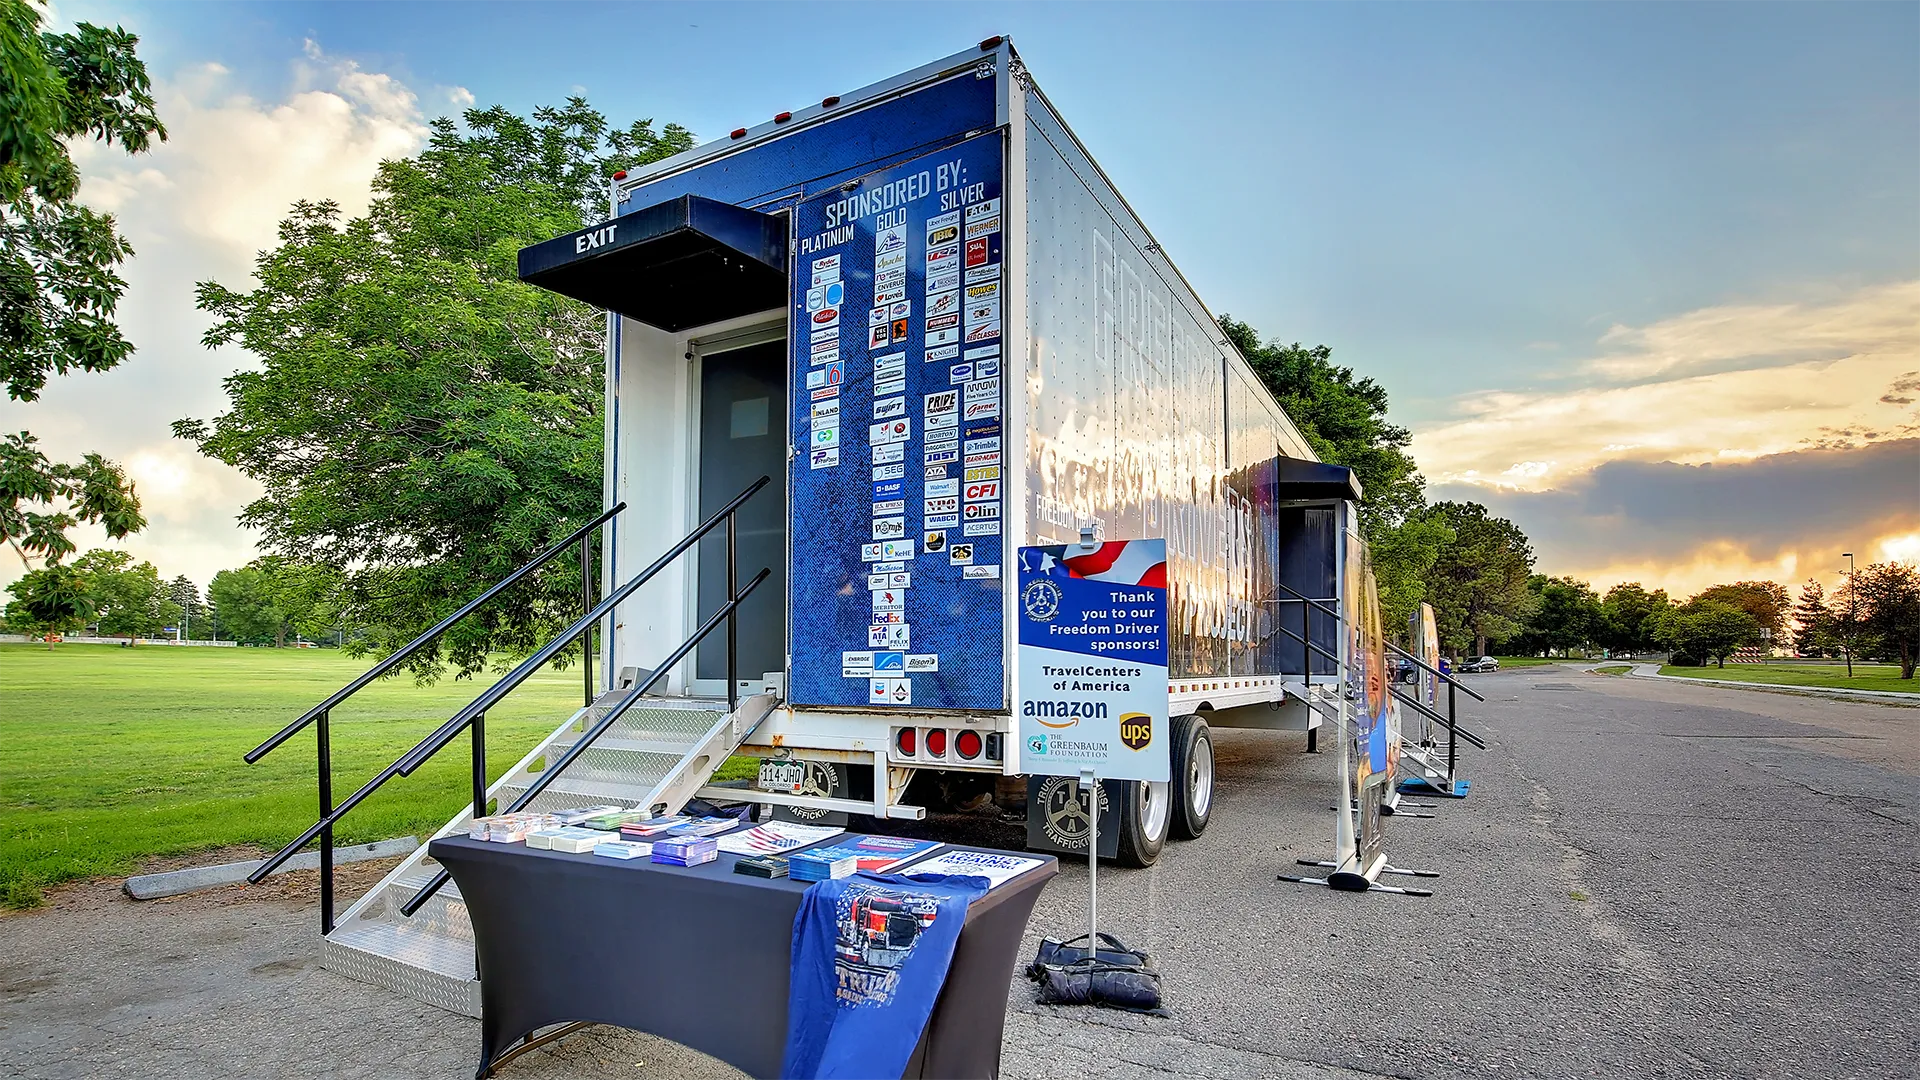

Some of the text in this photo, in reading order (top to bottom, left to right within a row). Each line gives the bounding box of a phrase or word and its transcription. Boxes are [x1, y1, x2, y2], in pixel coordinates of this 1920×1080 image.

[826, 159, 967, 229] SPONSORED BY:
[941, 182, 984, 212] SILVER
[877, 207, 906, 231] GOLD
[940, 214, 958, 223] Freight
[967, 219, 998, 235] WERNER
[576, 224, 617, 254] EXIT
[802, 224, 854, 255] PLATINUM
[930, 247, 957, 260] TRP
[819, 258, 836, 267] Ryder
[878, 254, 904, 269] Apache
[934, 347, 957, 356] KNIGHT
[978, 361, 997, 370] Bendix
[829, 362, 840, 384] 6
[927, 393, 955, 409] PRIDE
[876, 402, 902, 413] SWIFT
[967, 403, 996, 417] Garner
[929, 430, 954, 439] HORTON
[973, 440, 997, 450] Trimble
[926, 451, 956, 462] JOST
[885, 465, 903, 475] SEG
[926, 466, 946, 476] ATA
[967, 467, 999, 480] ESTES
[885, 483, 900, 491] BASF
[966, 484, 996, 498] CFI
[966, 523, 998, 531] ACERTUS
[1110, 591, 1155, 603] Thank
[874, 613, 900, 623] FedEx
[1081, 608, 1155, 622] you to our
[1050, 622, 1159, 635] Freedom Driver
[873, 632, 887, 640] ATA
[1090, 639, 1160, 652] sponsors!
[1042, 666, 1141, 677] TravelCenters
[1053, 681, 1130, 692] of America
[1023, 700, 1108, 719] amazon
[1122, 724, 1150, 745] ups
[1050, 741, 1108, 751] GREENBAUM
[1050, 750, 1108, 758] FOUNDATION
